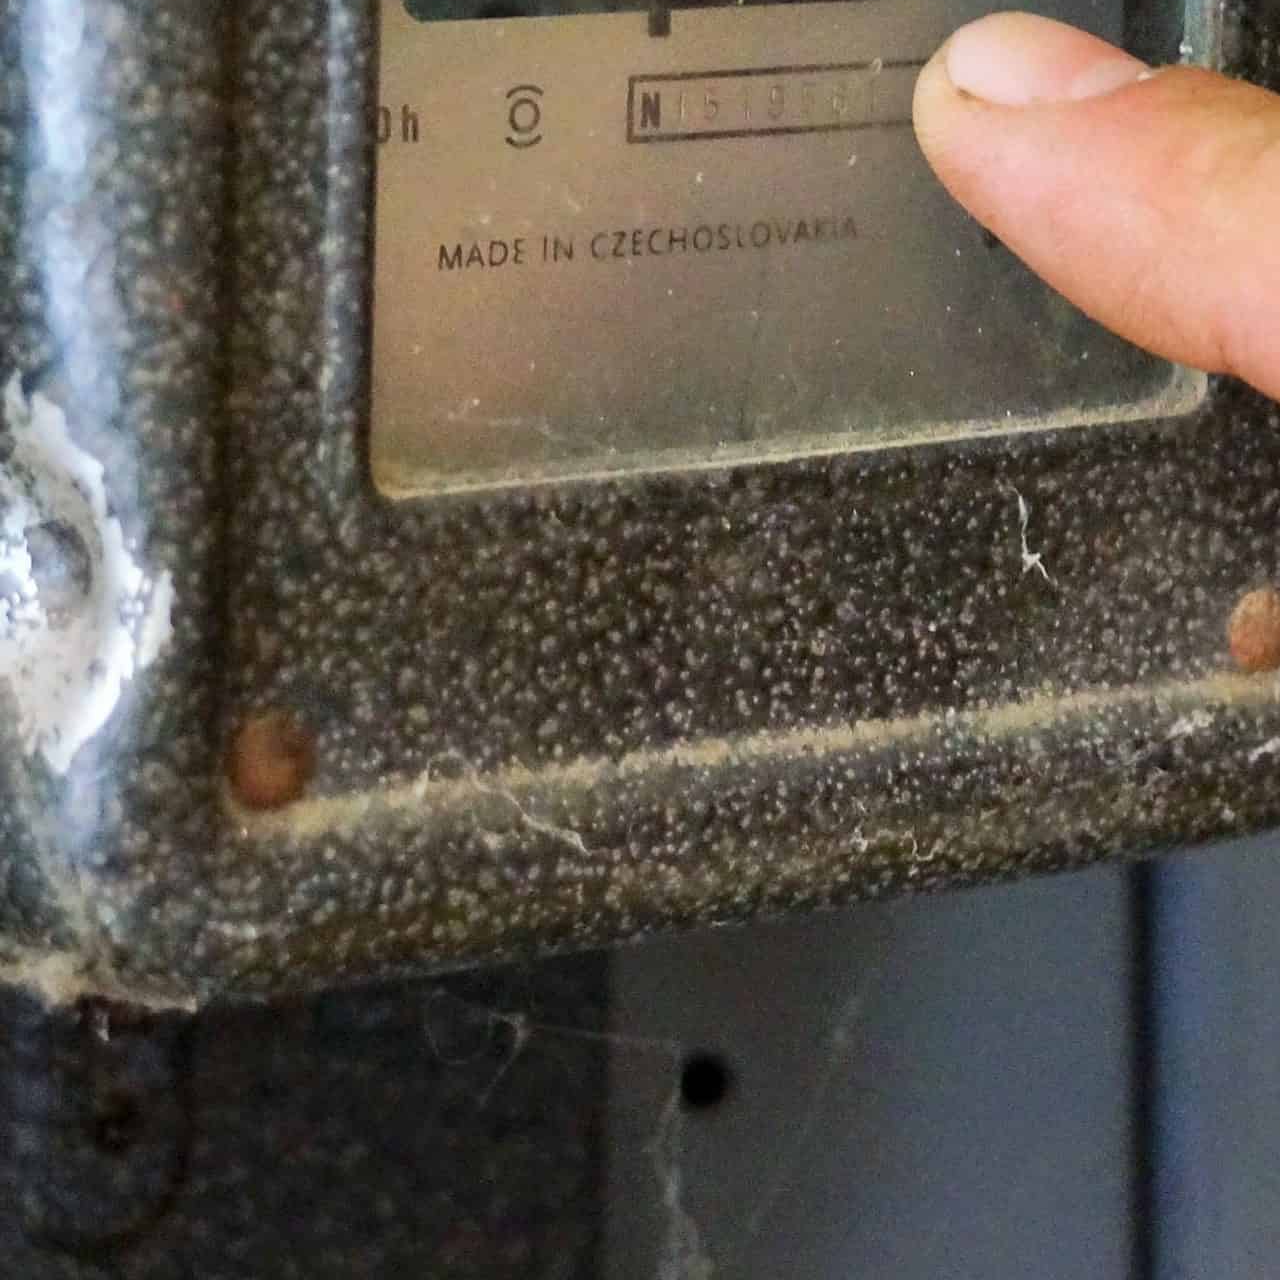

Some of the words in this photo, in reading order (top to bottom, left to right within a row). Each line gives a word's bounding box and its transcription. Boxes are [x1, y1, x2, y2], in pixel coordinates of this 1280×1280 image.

[437, 236, 524, 271] MADE
[543, 234, 574, 262] IN
[590, 217, 858, 261] CZECHOSLOVAKIA
